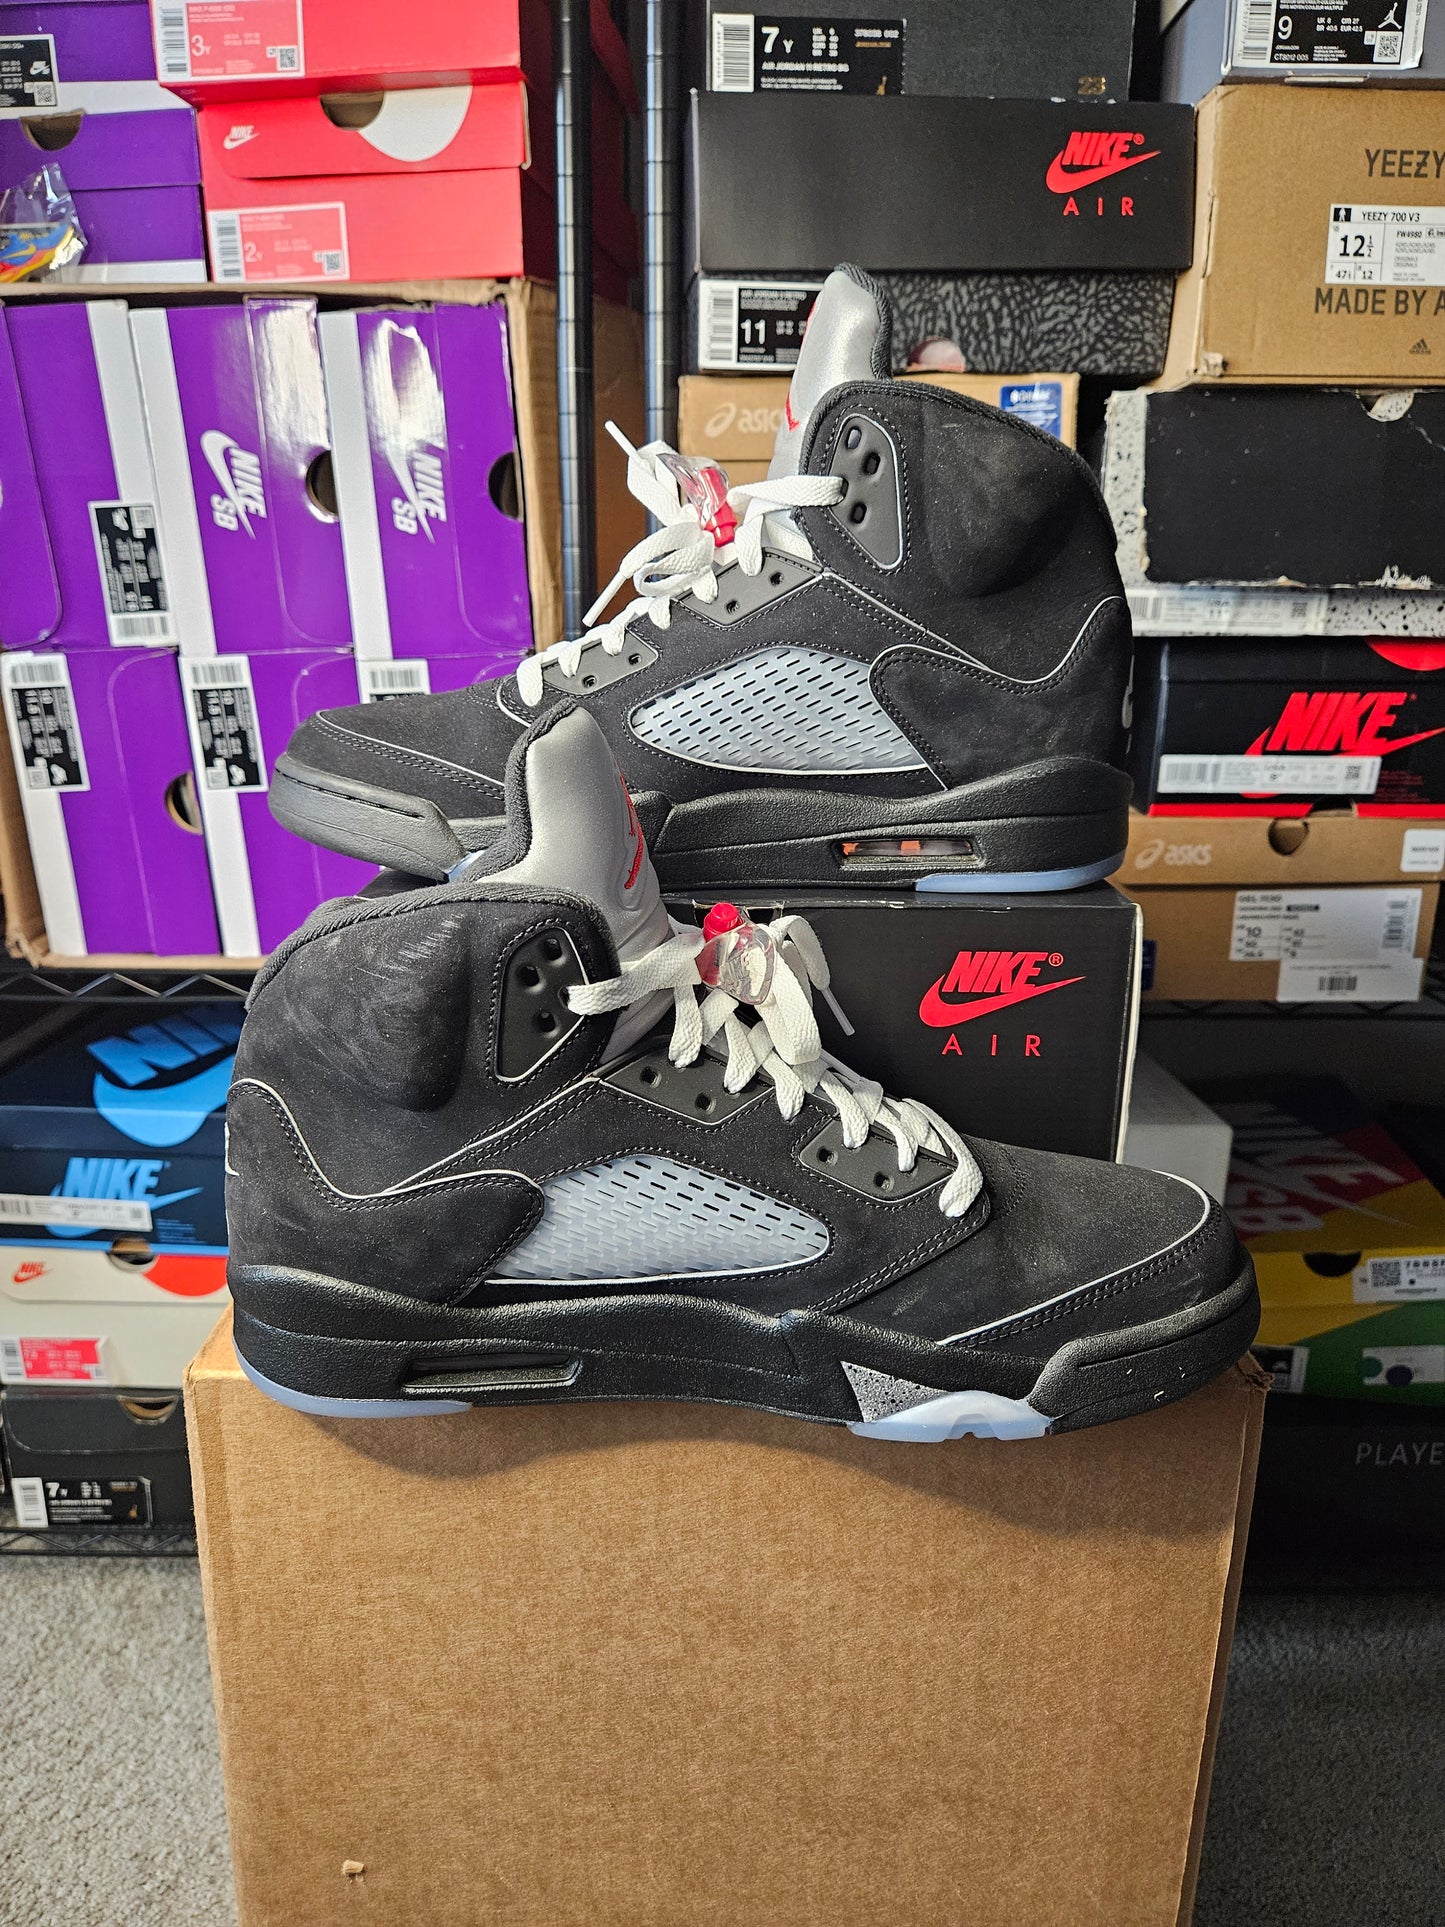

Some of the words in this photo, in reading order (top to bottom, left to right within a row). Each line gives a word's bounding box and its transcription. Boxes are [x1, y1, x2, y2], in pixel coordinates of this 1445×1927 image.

[1277, 15, 1293, 40] 9
[230, 125, 255, 139] NIKE
[1061, 131, 1134, 166] NIKE
[1364, 148, 1445, 178] YEEZY
[1063, 196, 1134, 216] AIR
[1361, 211, 1388, 220] YEEZY
[1391, 212, 1407, 222] 700
[1408, 212, 1421, 222] V3
[1313, 286, 1386, 315] MADE
[1394, 288, 1427, 316] BY
[740, 319, 766, 345] 11
[737, 408, 784, 433] asic
[229, 446, 268, 519] NIKE
[411, 449, 448, 523] NIKE
[210, 493, 239, 532] SB
[391, 497, 419, 535] SB
[1265, 691, 1408, 751] NIKE
[1163, 843, 1212, 867] asics
[941, 951, 1049, 994] NIKE
[85, 1005, 243, 1087] NIK
[941, 1033, 1041, 1057] AIR
[61, 1157, 165, 1200] NIKE
[18, 1261, 44, 1273] NIKE
